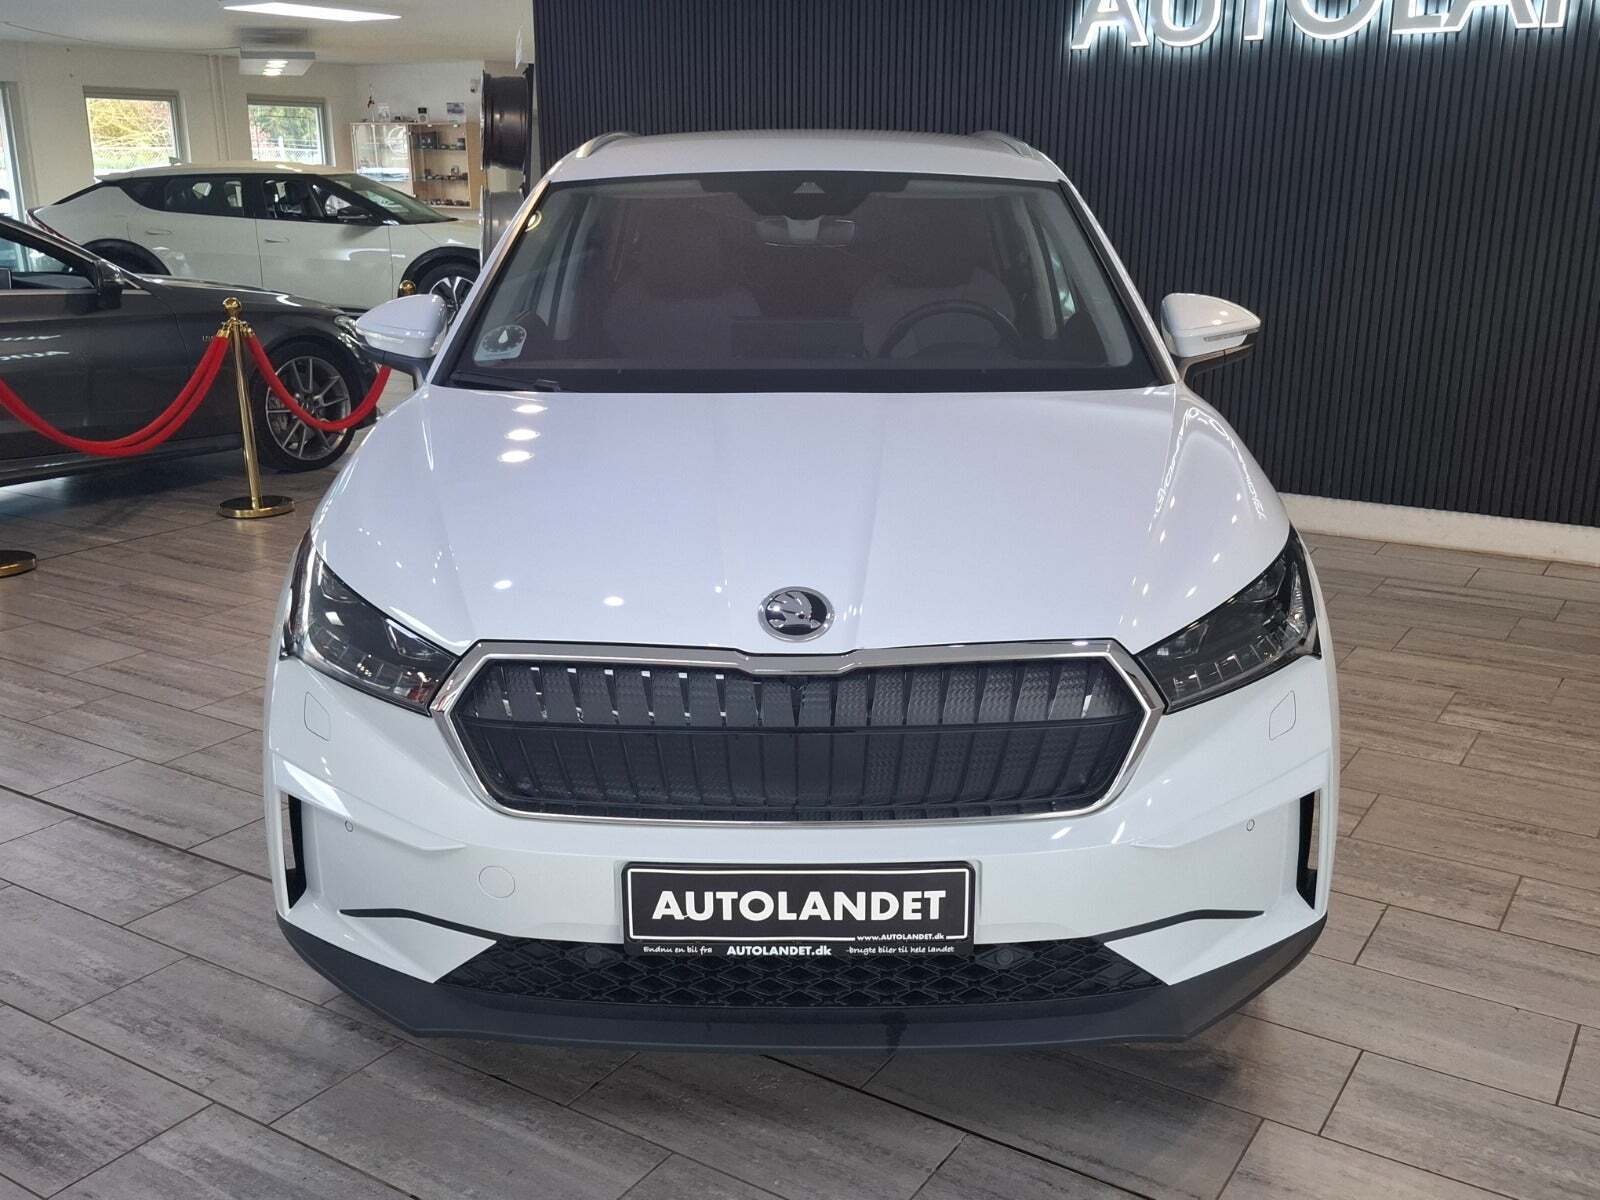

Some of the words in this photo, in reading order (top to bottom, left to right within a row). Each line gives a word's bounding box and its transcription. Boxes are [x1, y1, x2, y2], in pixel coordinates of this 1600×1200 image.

[652, 890, 947, 921] AUTOLANDET
[857, 932, 945, 941] www.AUTOLANDET.dk
[687, 945, 699, 954] bil
[700, 945, 713, 956] fra
[726, 944, 832, 956] AUTOLANDET.dk
[878, 945, 897, 954] biler
[898, 945, 908, 953] til
[910, 945, 926, 953] hele
